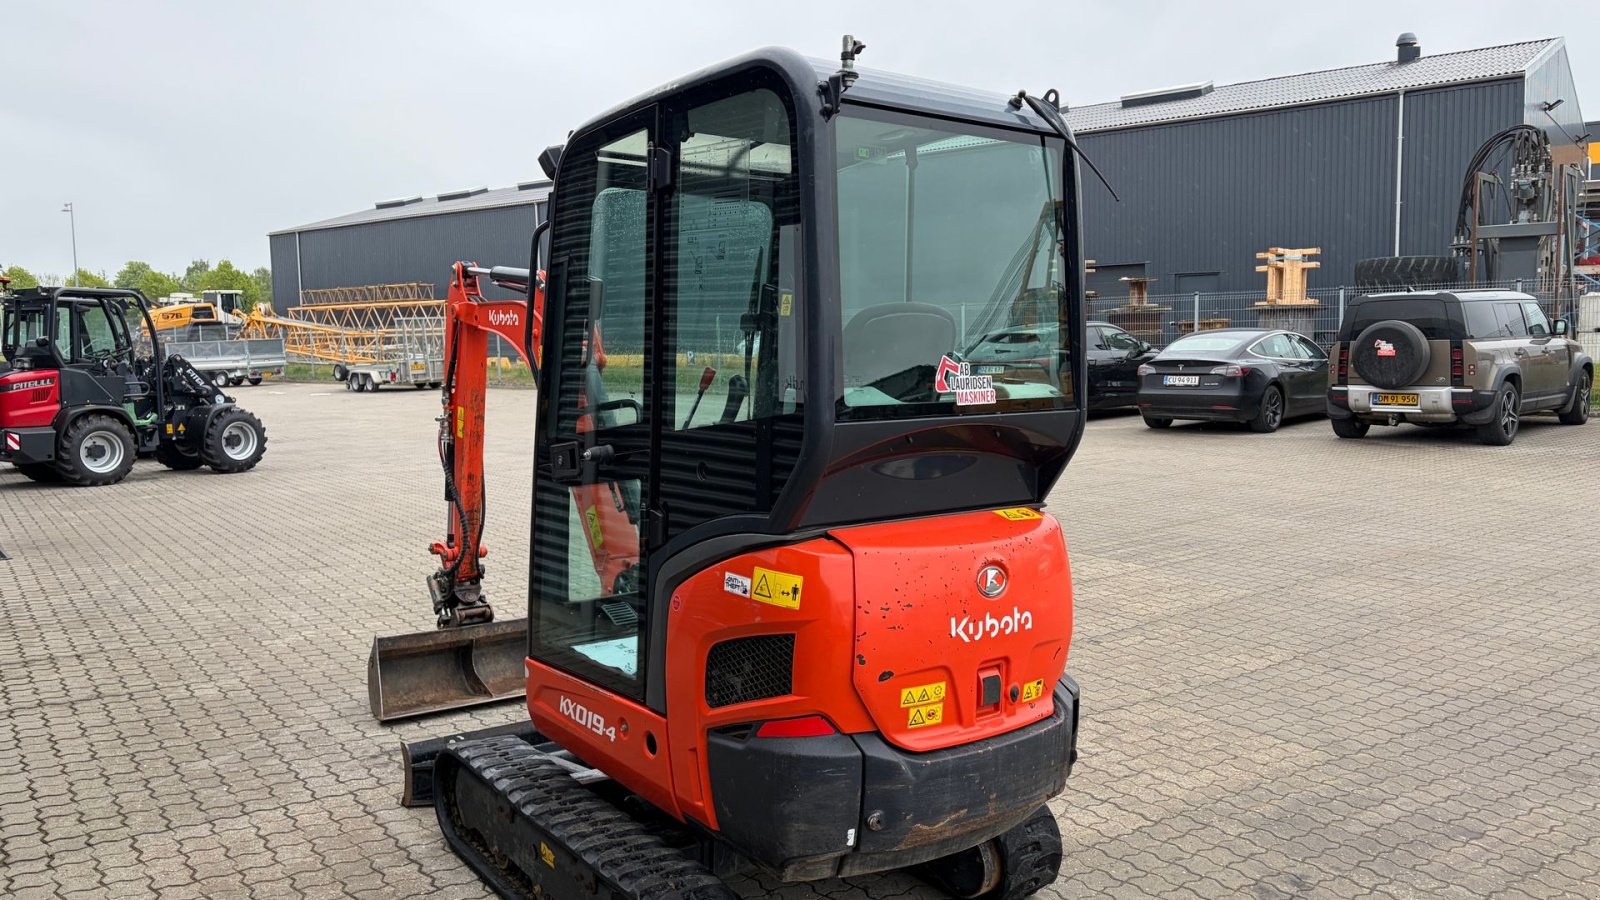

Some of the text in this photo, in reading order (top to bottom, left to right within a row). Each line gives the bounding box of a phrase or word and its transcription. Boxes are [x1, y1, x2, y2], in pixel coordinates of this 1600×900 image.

[488, 309, 519, 326] Kubota
[960, 363, 970, 376] AB
[13, 378, 52, 390] PITBULL
[950, 376, 992, 391] LAURIDSEN
[957, 391, 995, 404] MASKINER
[1378, 395, 1416, 404] DM 91 956
[950, 606, 1033, 643] Kubota
